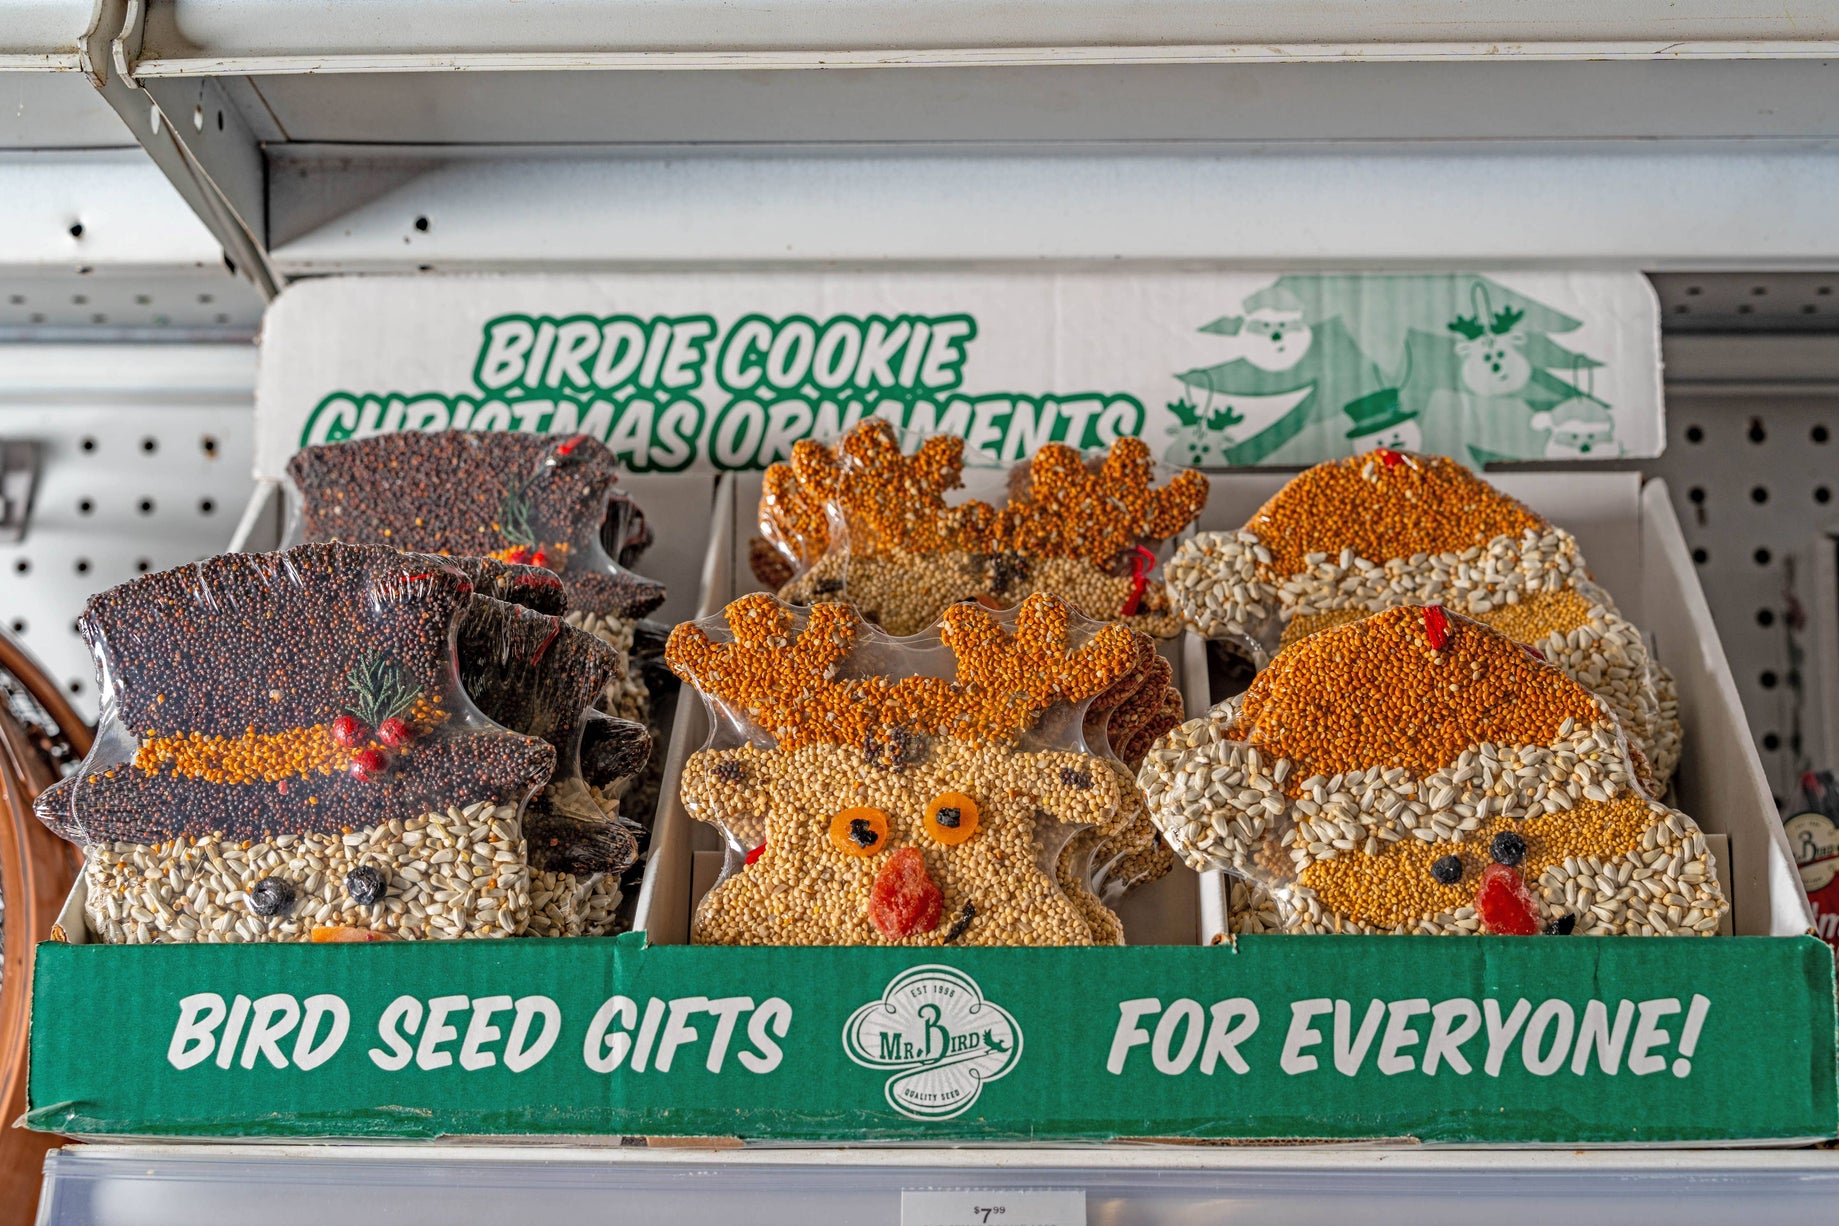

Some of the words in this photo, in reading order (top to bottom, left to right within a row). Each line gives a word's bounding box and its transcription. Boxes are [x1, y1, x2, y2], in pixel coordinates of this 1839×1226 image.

[477, 317, 714, 391] BIRDIE
[719, 317, 974, 391] COOKIE
[910, 985, 928, 998] EST
[166, 992, 351, 1071] BIRD
[368, 994, 562, 1072] SEED
[583, 995, 793, 1074] GIFTS
[1106, 997, 1261, 1076] FOR
[1280, 993, 1711, 1079] EVERYONE!
[904, 1088, 937, 1101] QUALITY
[941, 1089, 960, 1101] SEED
